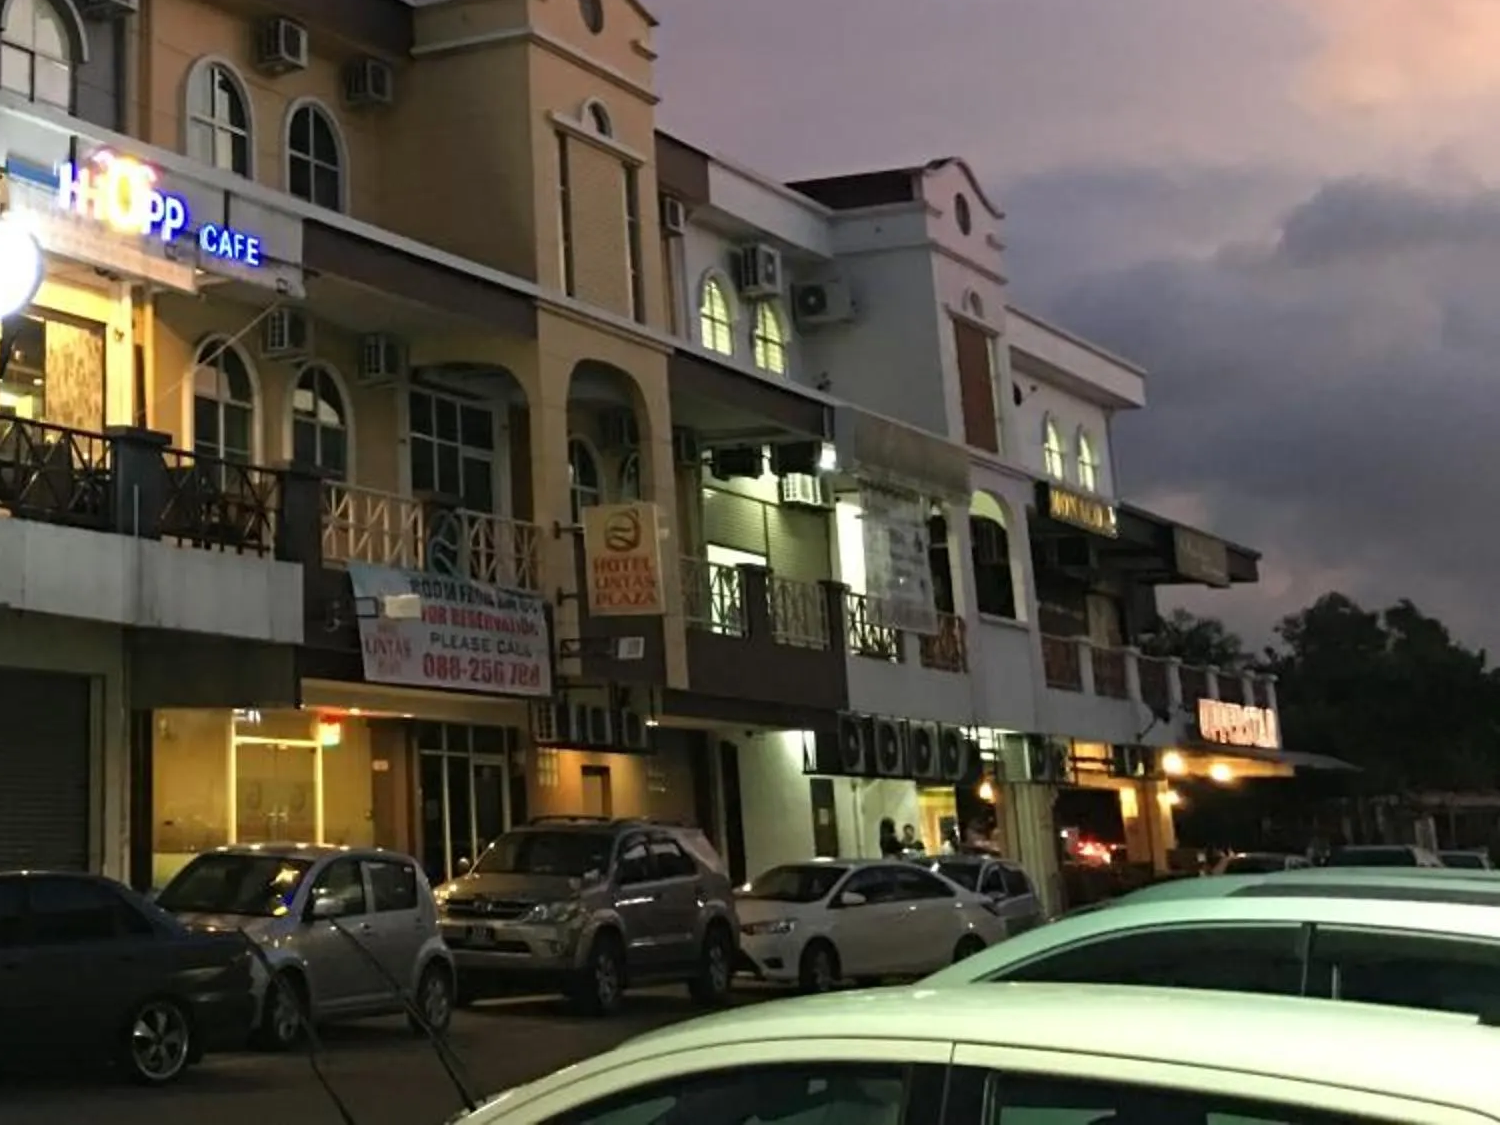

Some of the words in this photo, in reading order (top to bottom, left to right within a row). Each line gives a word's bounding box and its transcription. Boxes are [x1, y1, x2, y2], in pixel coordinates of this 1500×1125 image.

[200, 224, 260, 267] CAFE
[592, 556, 650, 573] HOTEL
[429, 631, 491, 653] PLEASE
